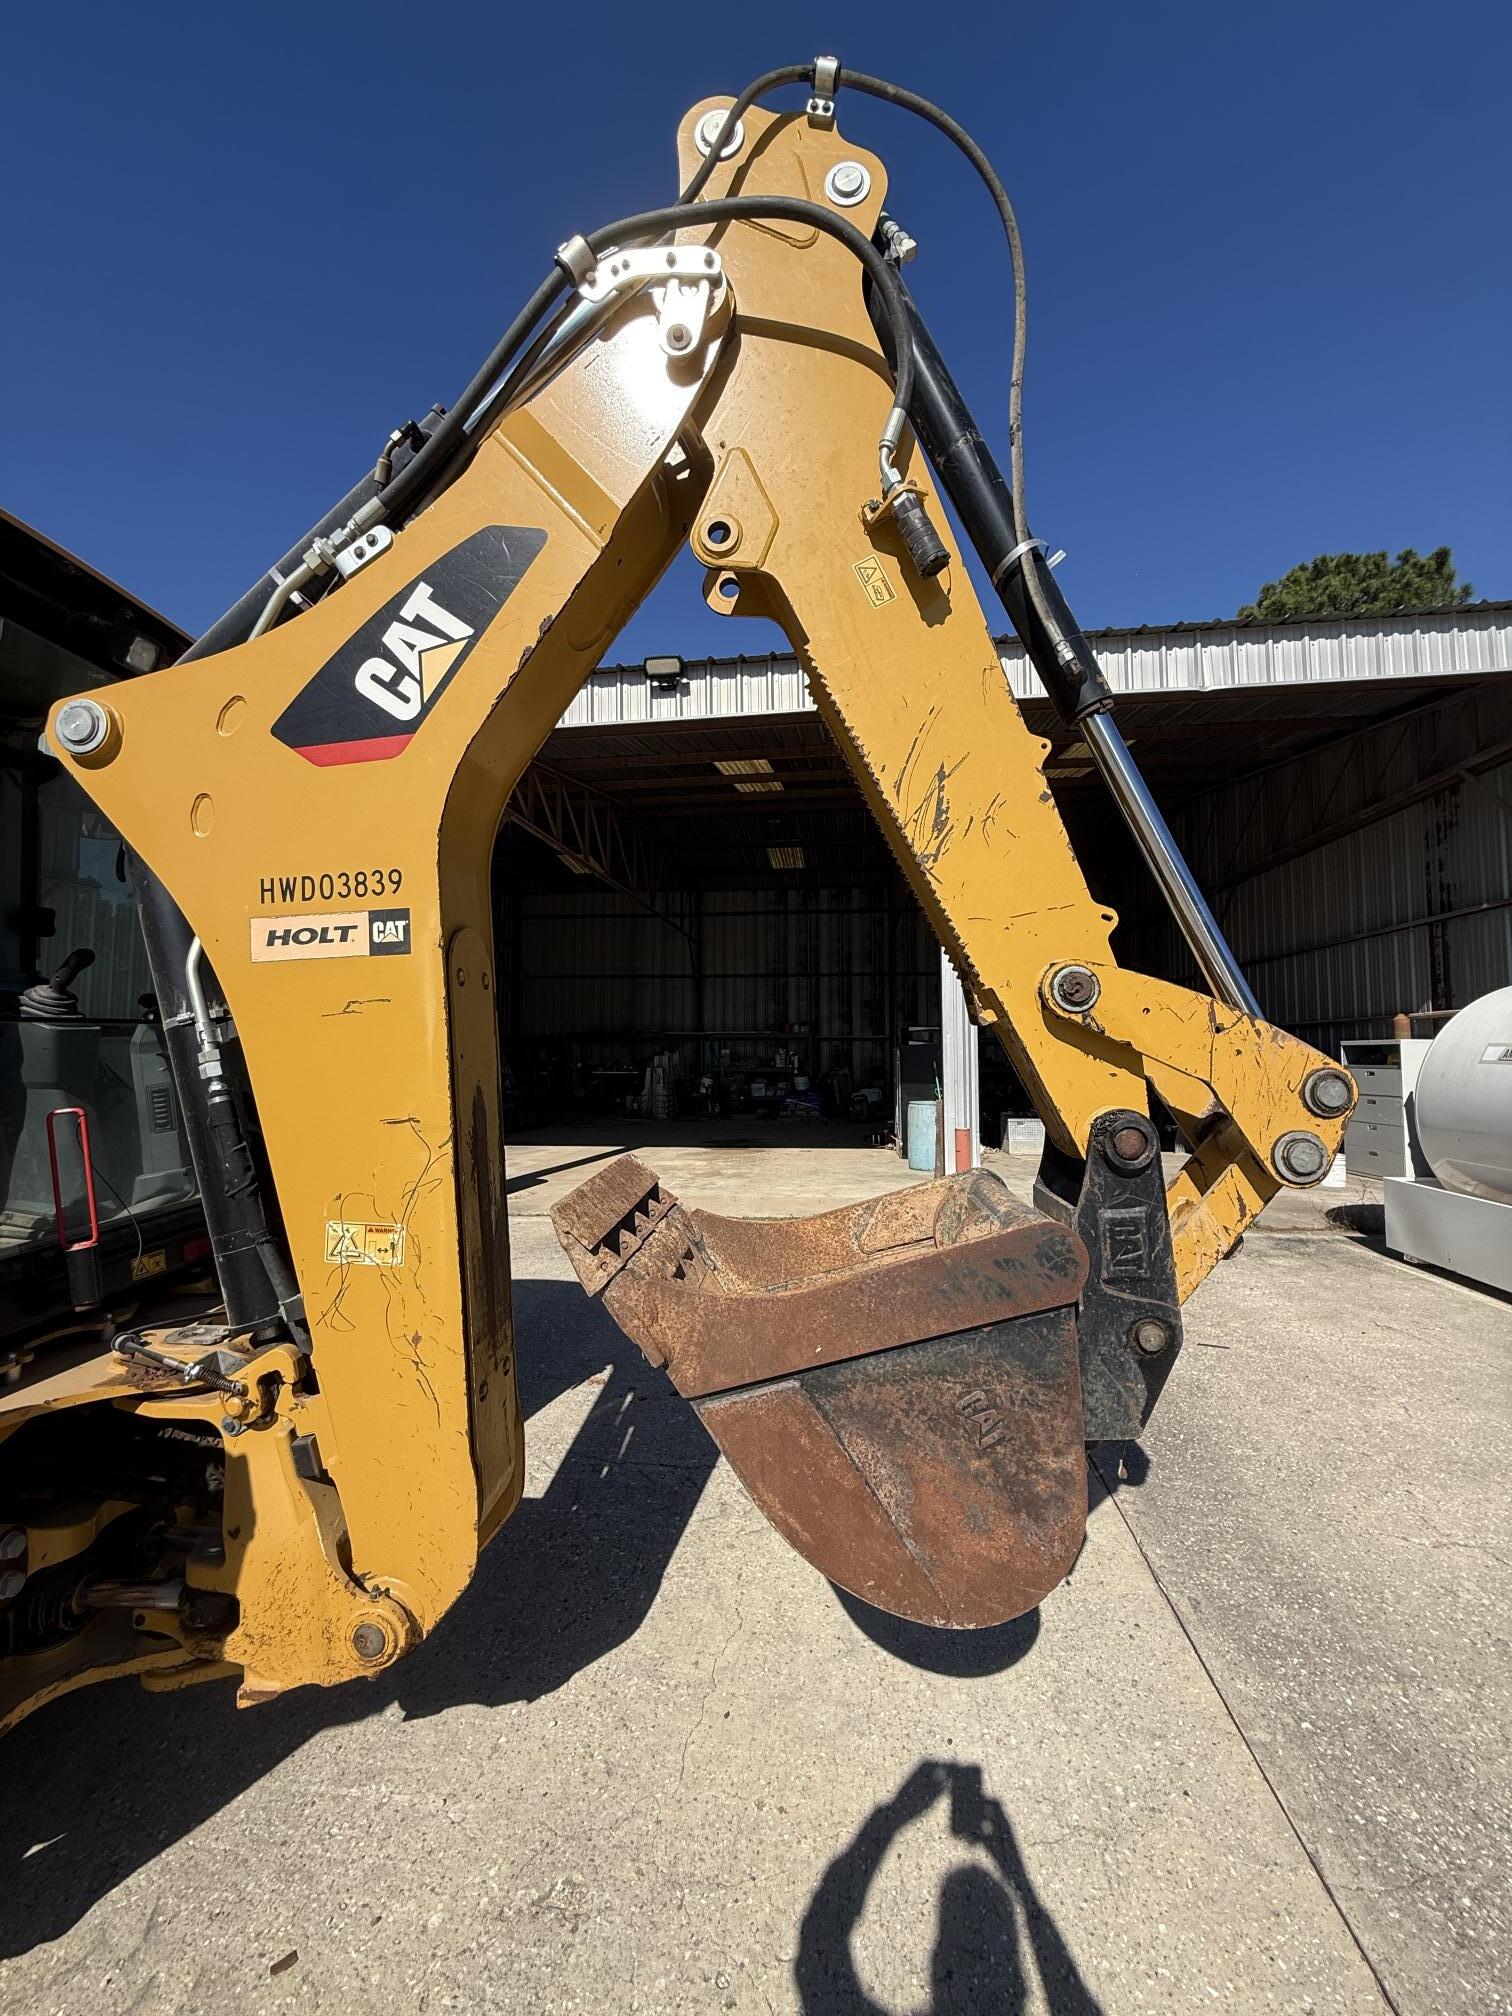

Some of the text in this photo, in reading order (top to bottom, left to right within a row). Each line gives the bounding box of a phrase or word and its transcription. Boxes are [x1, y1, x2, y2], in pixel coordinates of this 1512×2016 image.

[355, 581, 475, 721] CAT
[260, 868, 403, 904] HWD03839
[266, 920, 406, 946] HOLT CAT
[955, 1390, 1005, 1450] CAT
